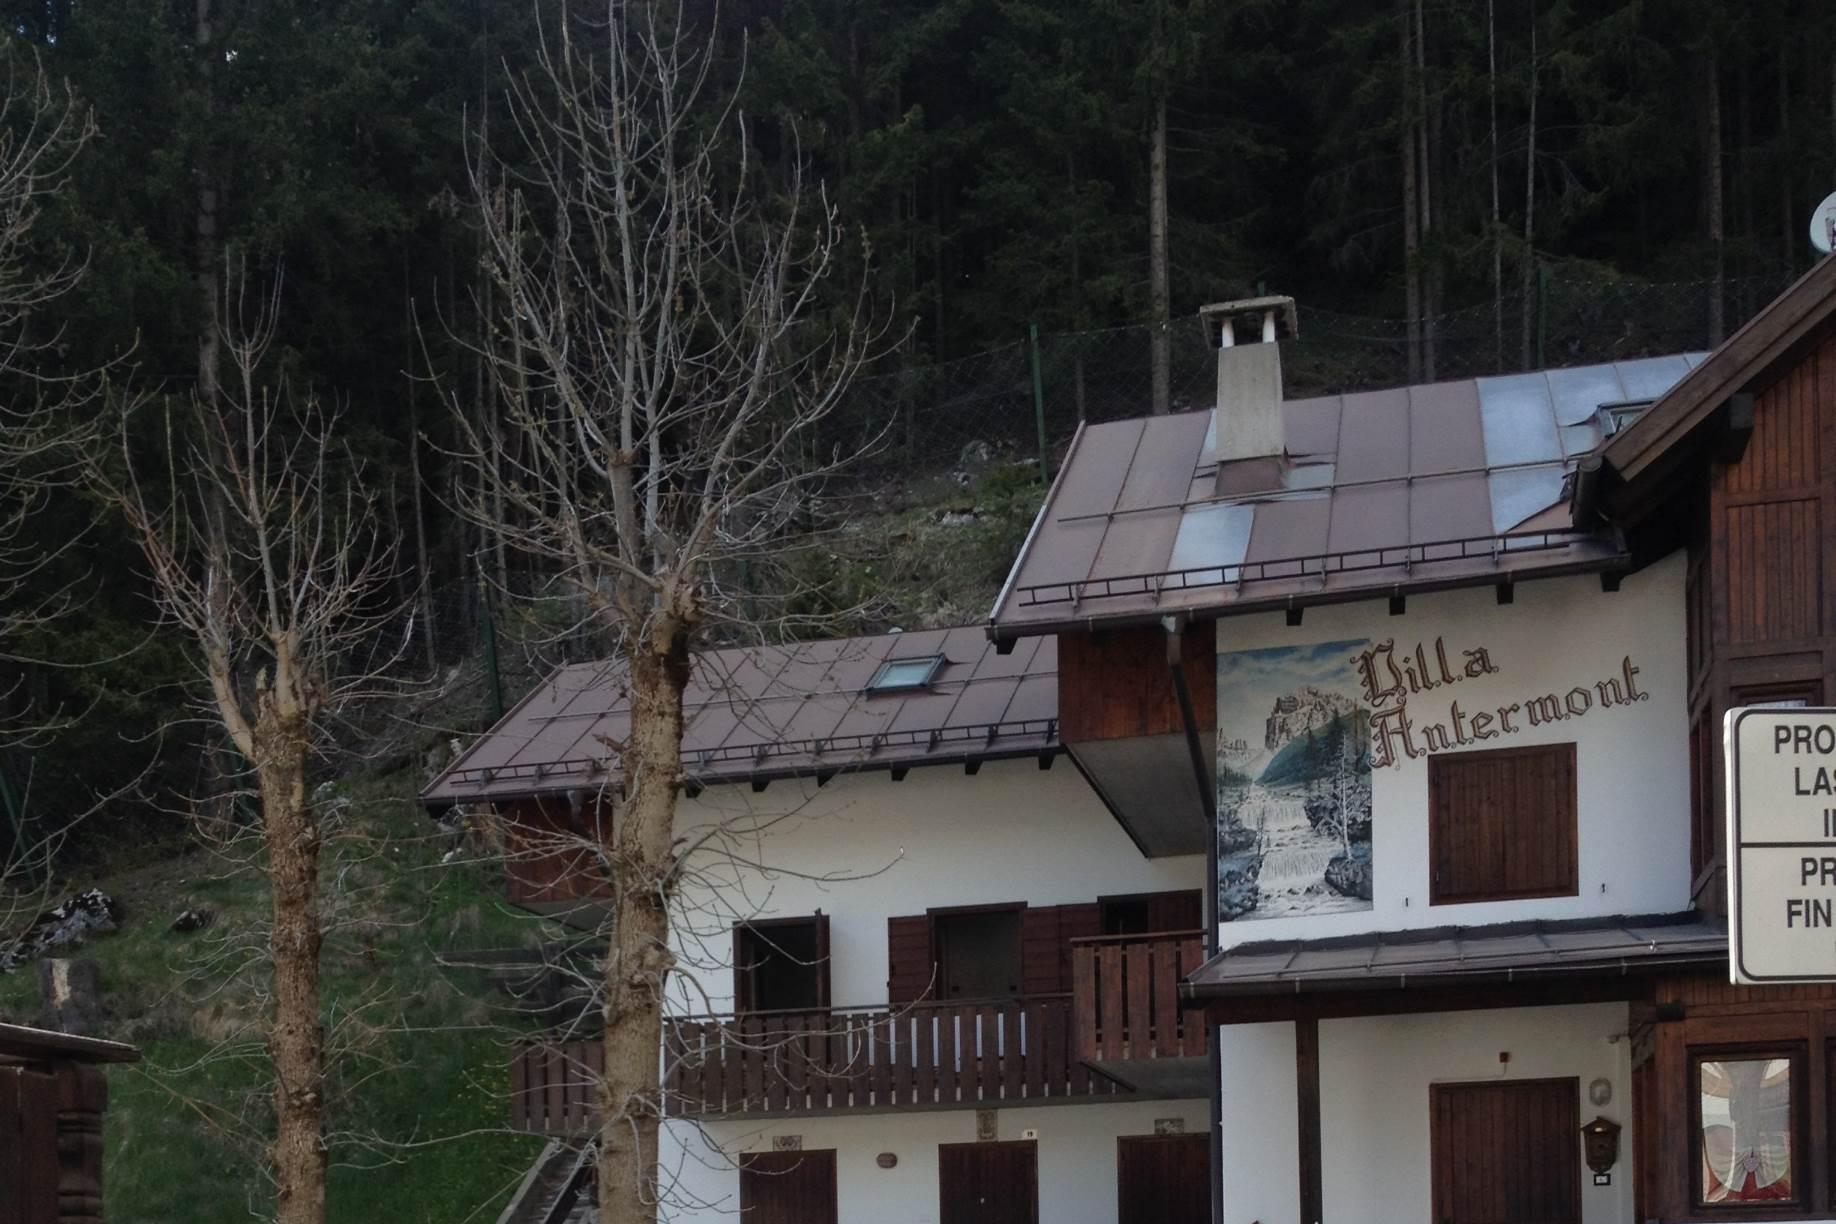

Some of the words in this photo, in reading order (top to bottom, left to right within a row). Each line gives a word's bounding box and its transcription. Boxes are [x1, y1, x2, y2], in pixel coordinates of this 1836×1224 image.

[1350, 636, 1499, 707] Villa
[1369, 656, 1649, 770] Antermont
[1794, 766, 1836, 796] LA
[1787, 899, 1832, 928] FIN
